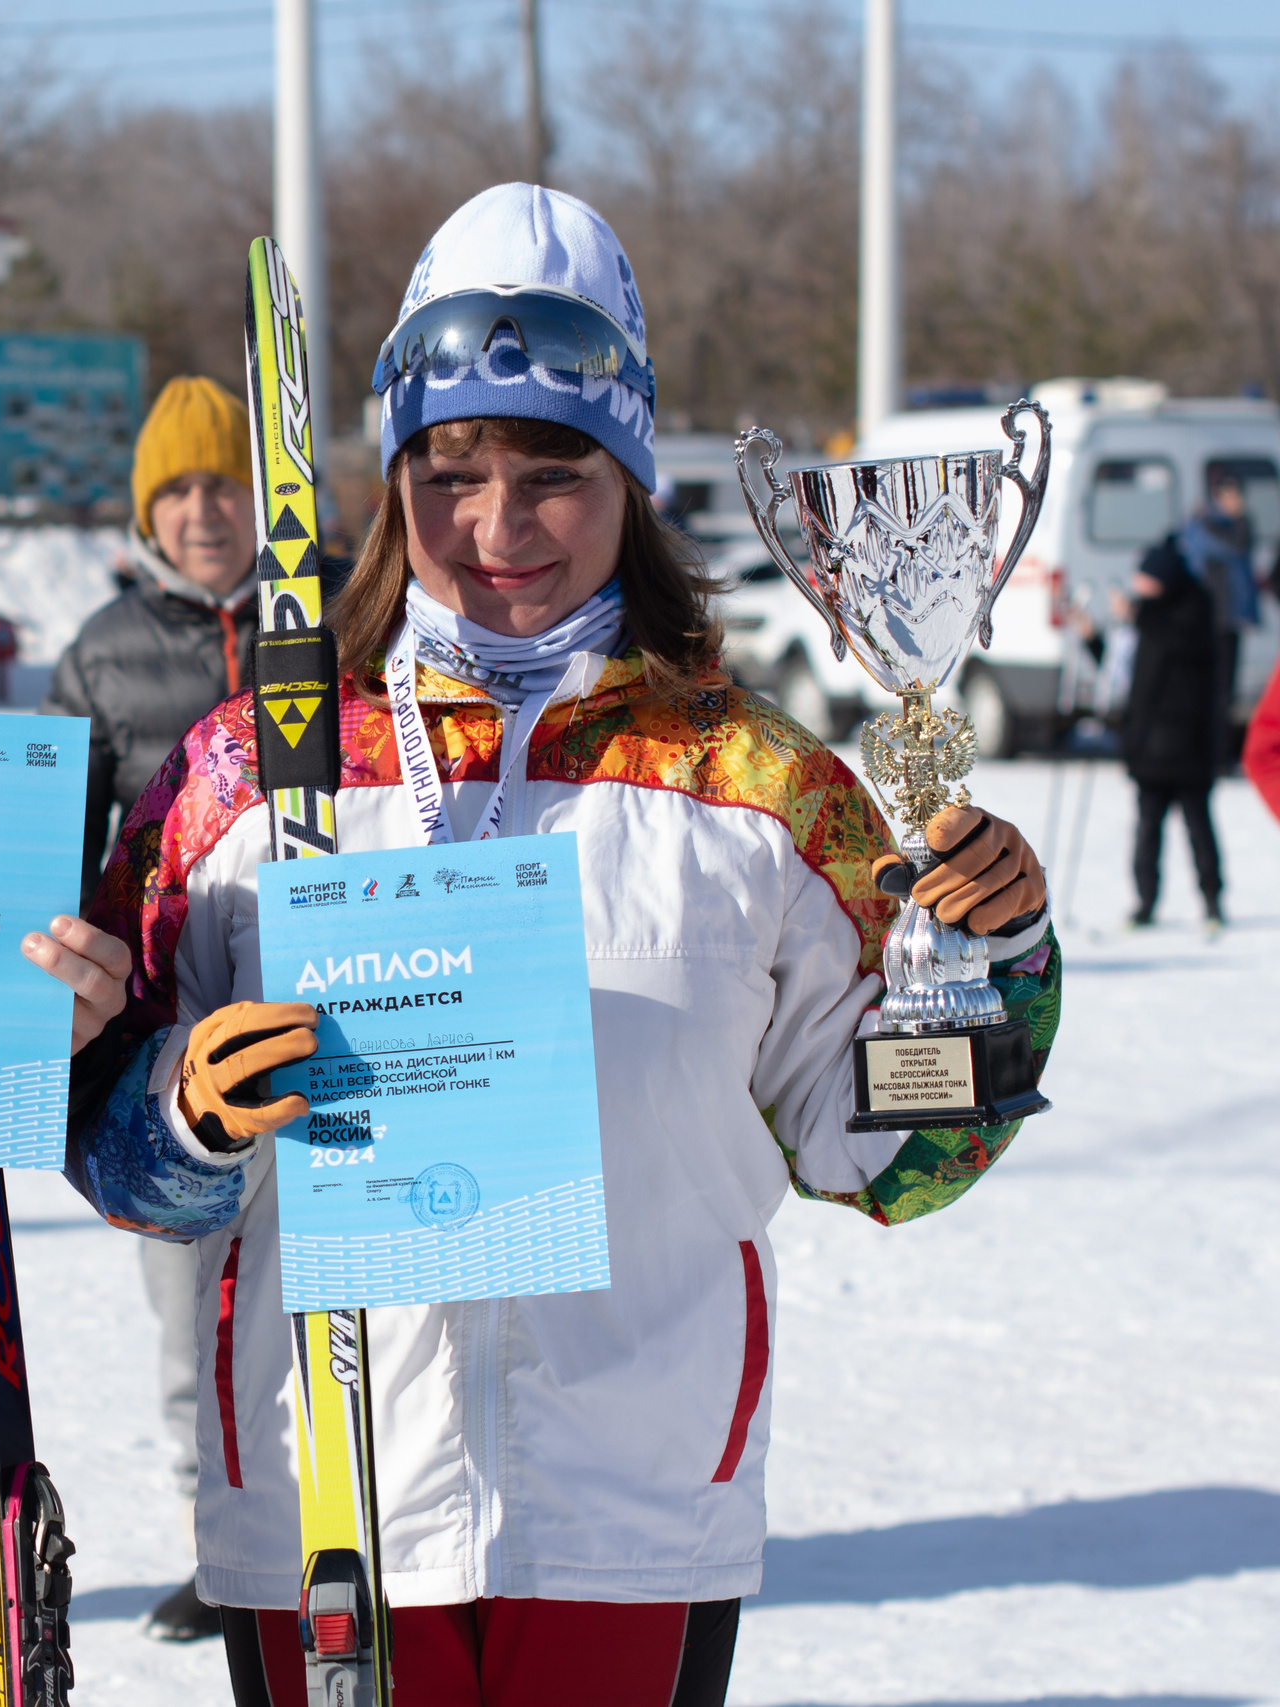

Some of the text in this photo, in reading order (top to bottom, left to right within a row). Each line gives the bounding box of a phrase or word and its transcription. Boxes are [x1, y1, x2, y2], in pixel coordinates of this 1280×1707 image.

[259, 681, 329, 695] FISCHER
[26, 743, 52, 751] СПОРТ
[393, 673, 445, 833] МАГНИТОГОРСК
[26, 751, 57, 759] НОРМА
[26, 759, 57, 767] ЖИЗНИ
[515, 862, 541, 872] СПОРТ
[516, 870, 547, 880] НОРМА
[290, 881, 346, 895] МАГНИТО
[517, 878, 547, 887] ЖИЗНИ
[308, 891, 347, 903] ГОРСК
[295, 945, 473, 995] ДИПЛОМ
[315, 990, 463, 1016] АГРАЖДАЕТСЯ
[895, 1047, 941, 1057] ПОБЕДИТЕЛЬ
[308, 1066, 326, 1077] ЗА
[338, 1061, 382, 1074] МЕСТО
[385, 1059, 404, 1070] НА
[406, 1052, 486, 1069] ДИСТАНЦИИ
[496, 1049, 516, 1060] КМ
[900, 1058, 937, 1068] ОТКРЫТАЯ
[310, 1081, 318, 1090] В
[347, 1067, 457, 1087] ВСЕРОССИЙСКОЙ
[890, 1068, 949, 1079] ВСЕРОССИЙСКАЯ
[311, 1078, 490, 1103] МАССОВОЙ ЛЫЖНОЙ ГОНКЕ
[873, 1079, 968, 1091] МАССОВАЯ ЛЫЖНАЯ ГОНКА
[307, 1109, 370, 1130] ЛЫЖНЯ
[309, 1125, 372, 1146] РОССИИ
[310, 1145, 375, 1169] 2024
[329, 1310, 358, 1385] SKA
[335, 1678, 344, 1707] ROFIL
